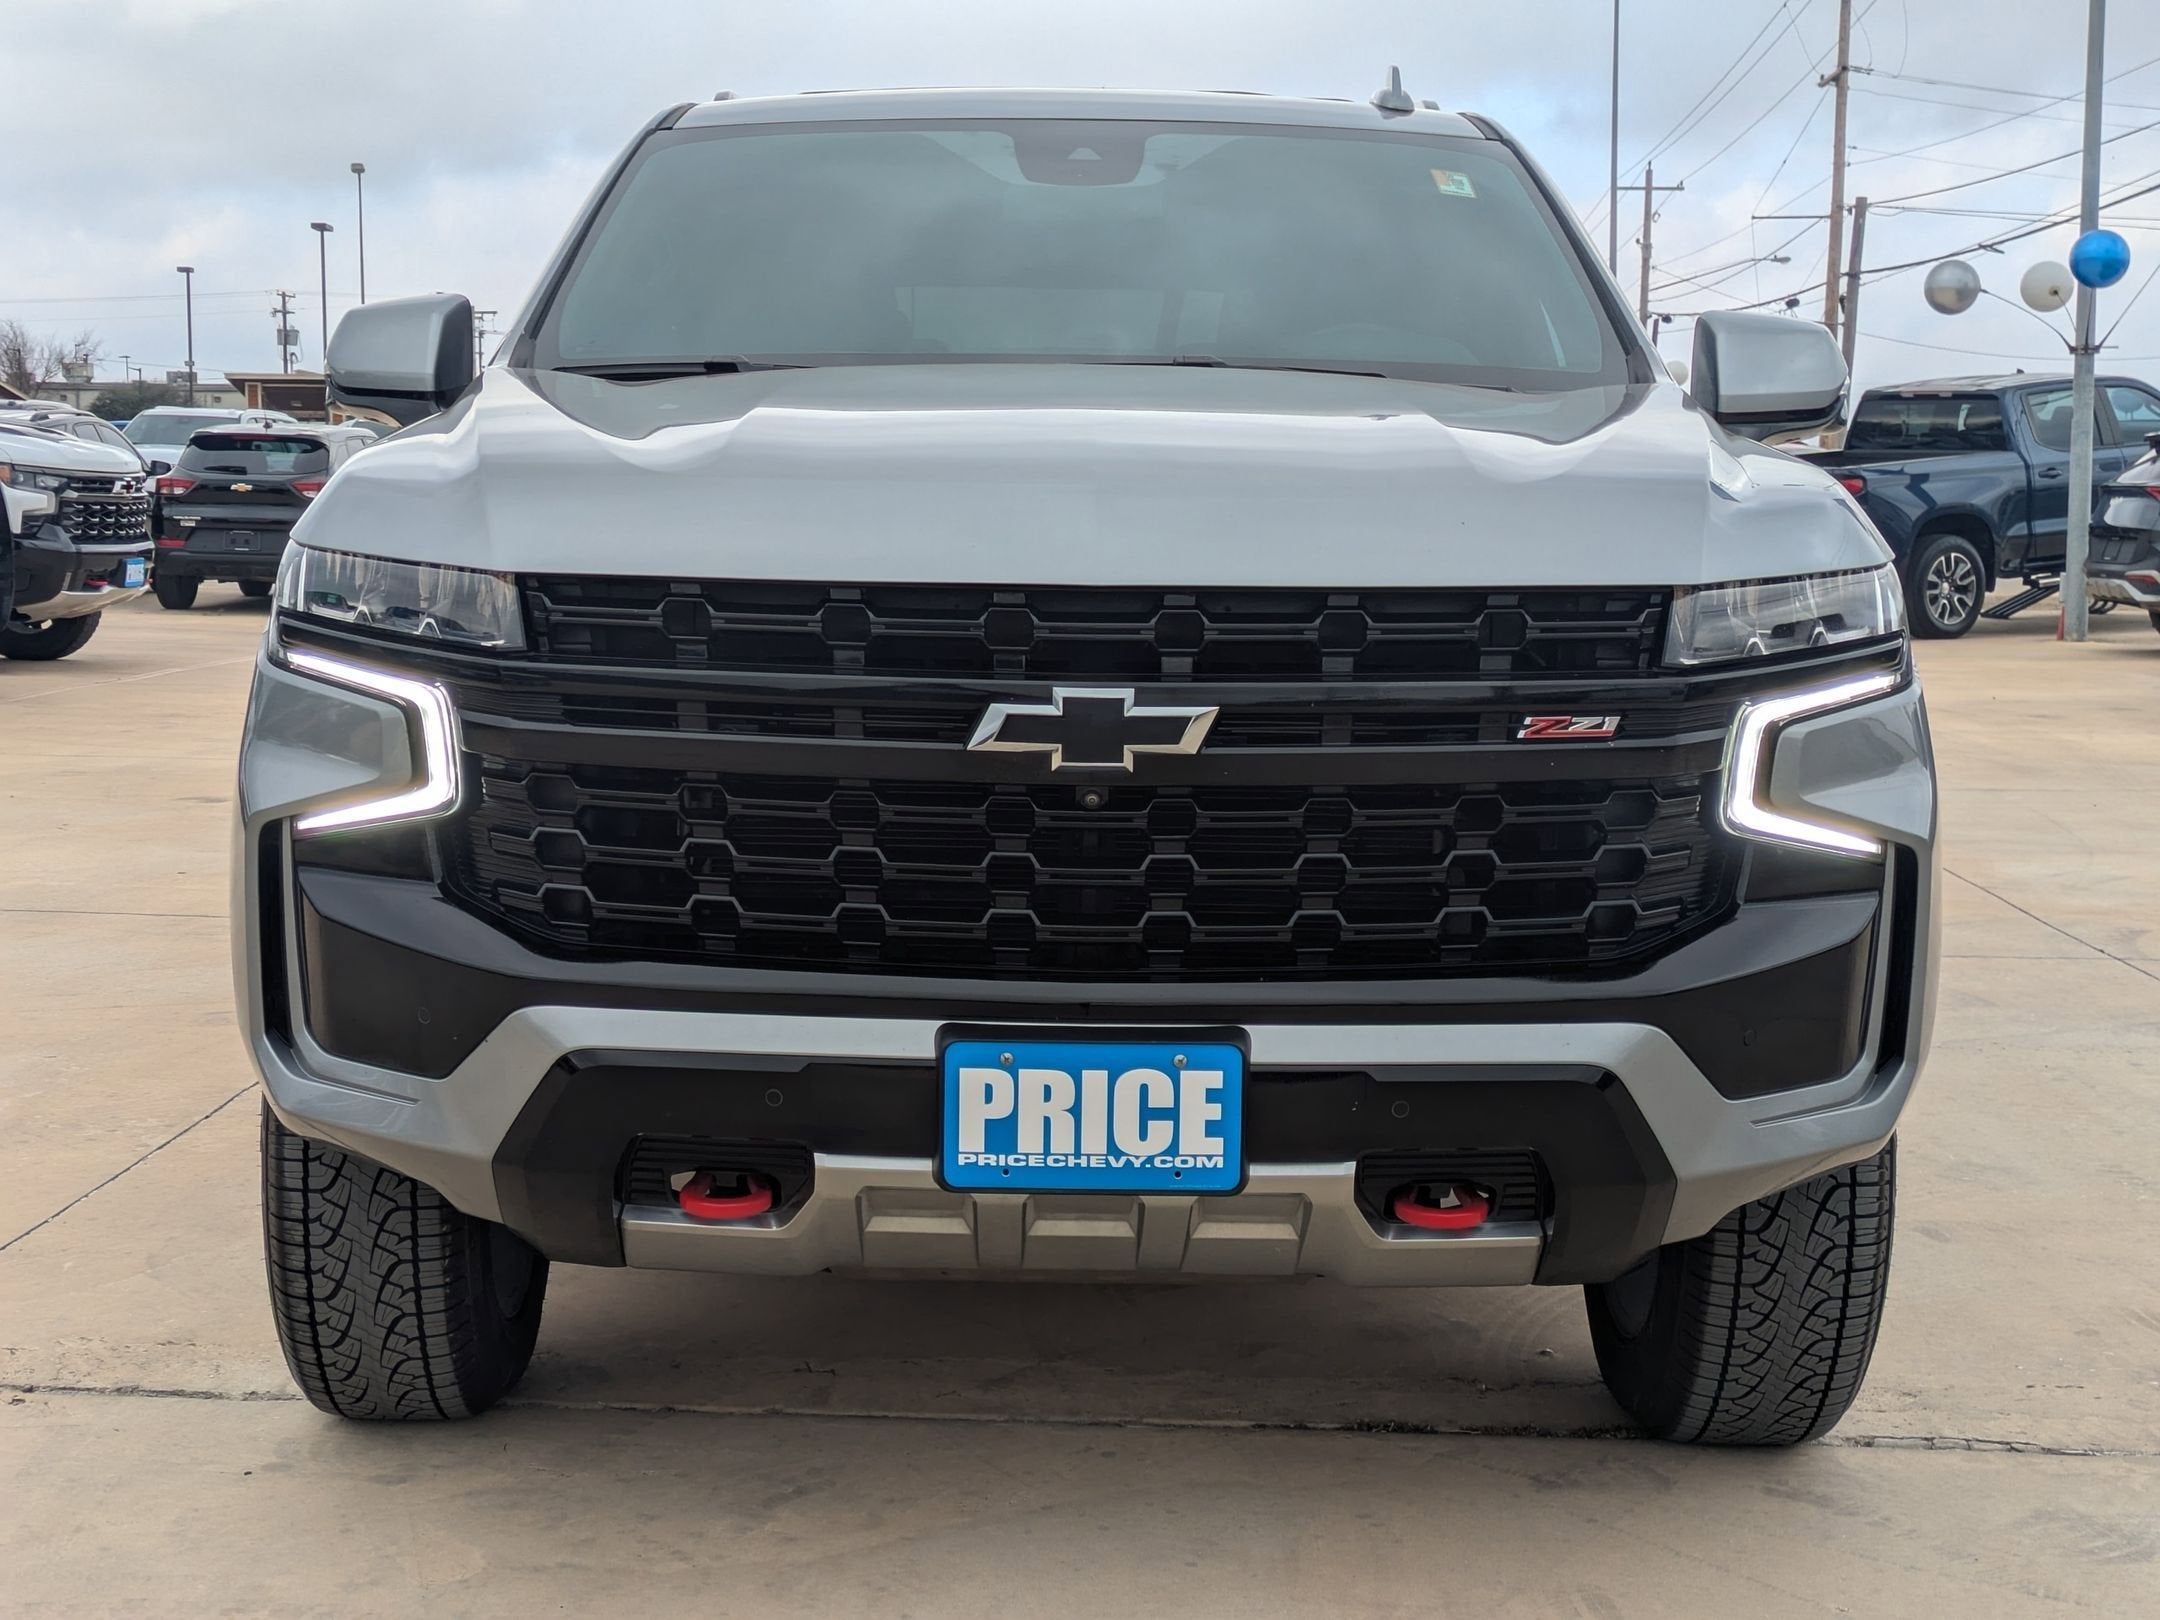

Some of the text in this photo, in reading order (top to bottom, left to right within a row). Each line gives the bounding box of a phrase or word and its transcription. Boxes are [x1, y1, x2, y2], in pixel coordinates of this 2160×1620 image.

[1516, 716, 1621, 739] Z71
[958, 1067, 1224, 1156] PRICE
[957, 1154, 1224, 1169] PRICECHEVY.COM
